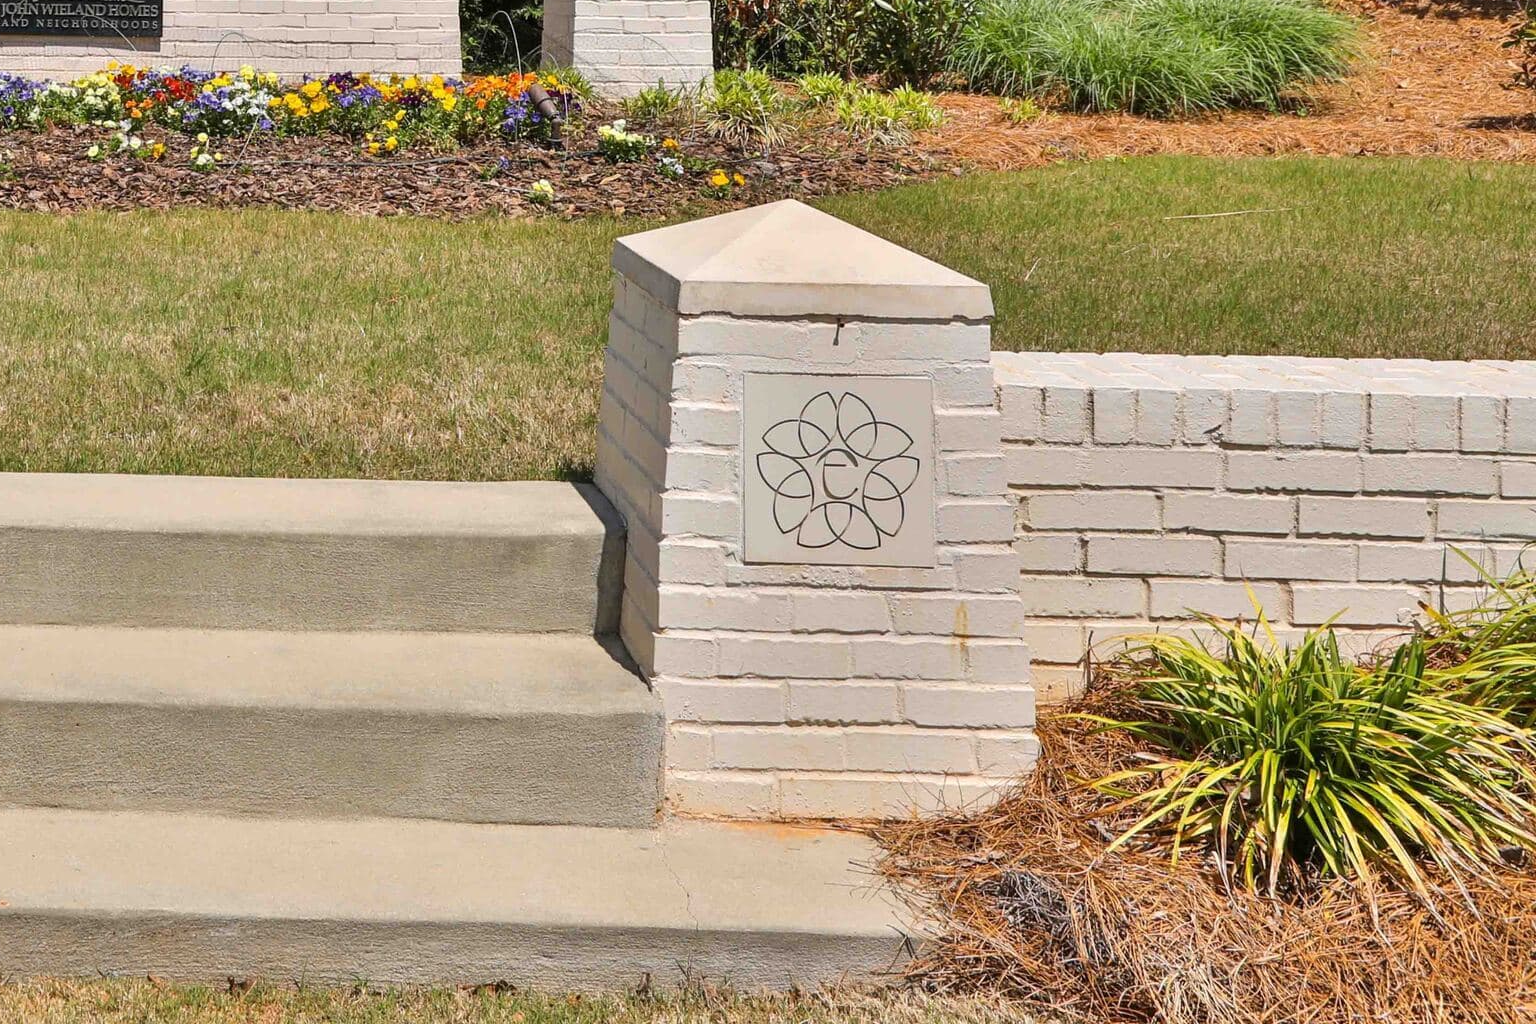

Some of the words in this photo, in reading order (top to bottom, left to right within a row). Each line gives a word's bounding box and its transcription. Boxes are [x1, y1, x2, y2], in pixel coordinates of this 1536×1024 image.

[0, 2, 39, 17] JOHN
[41, 2, 108, 17] WIELAND
[108, 4, 159, 18] HOMES
[1, 17, 30, 28] AND
[36, 18, 159, 29] NEIGHBORHOODS
